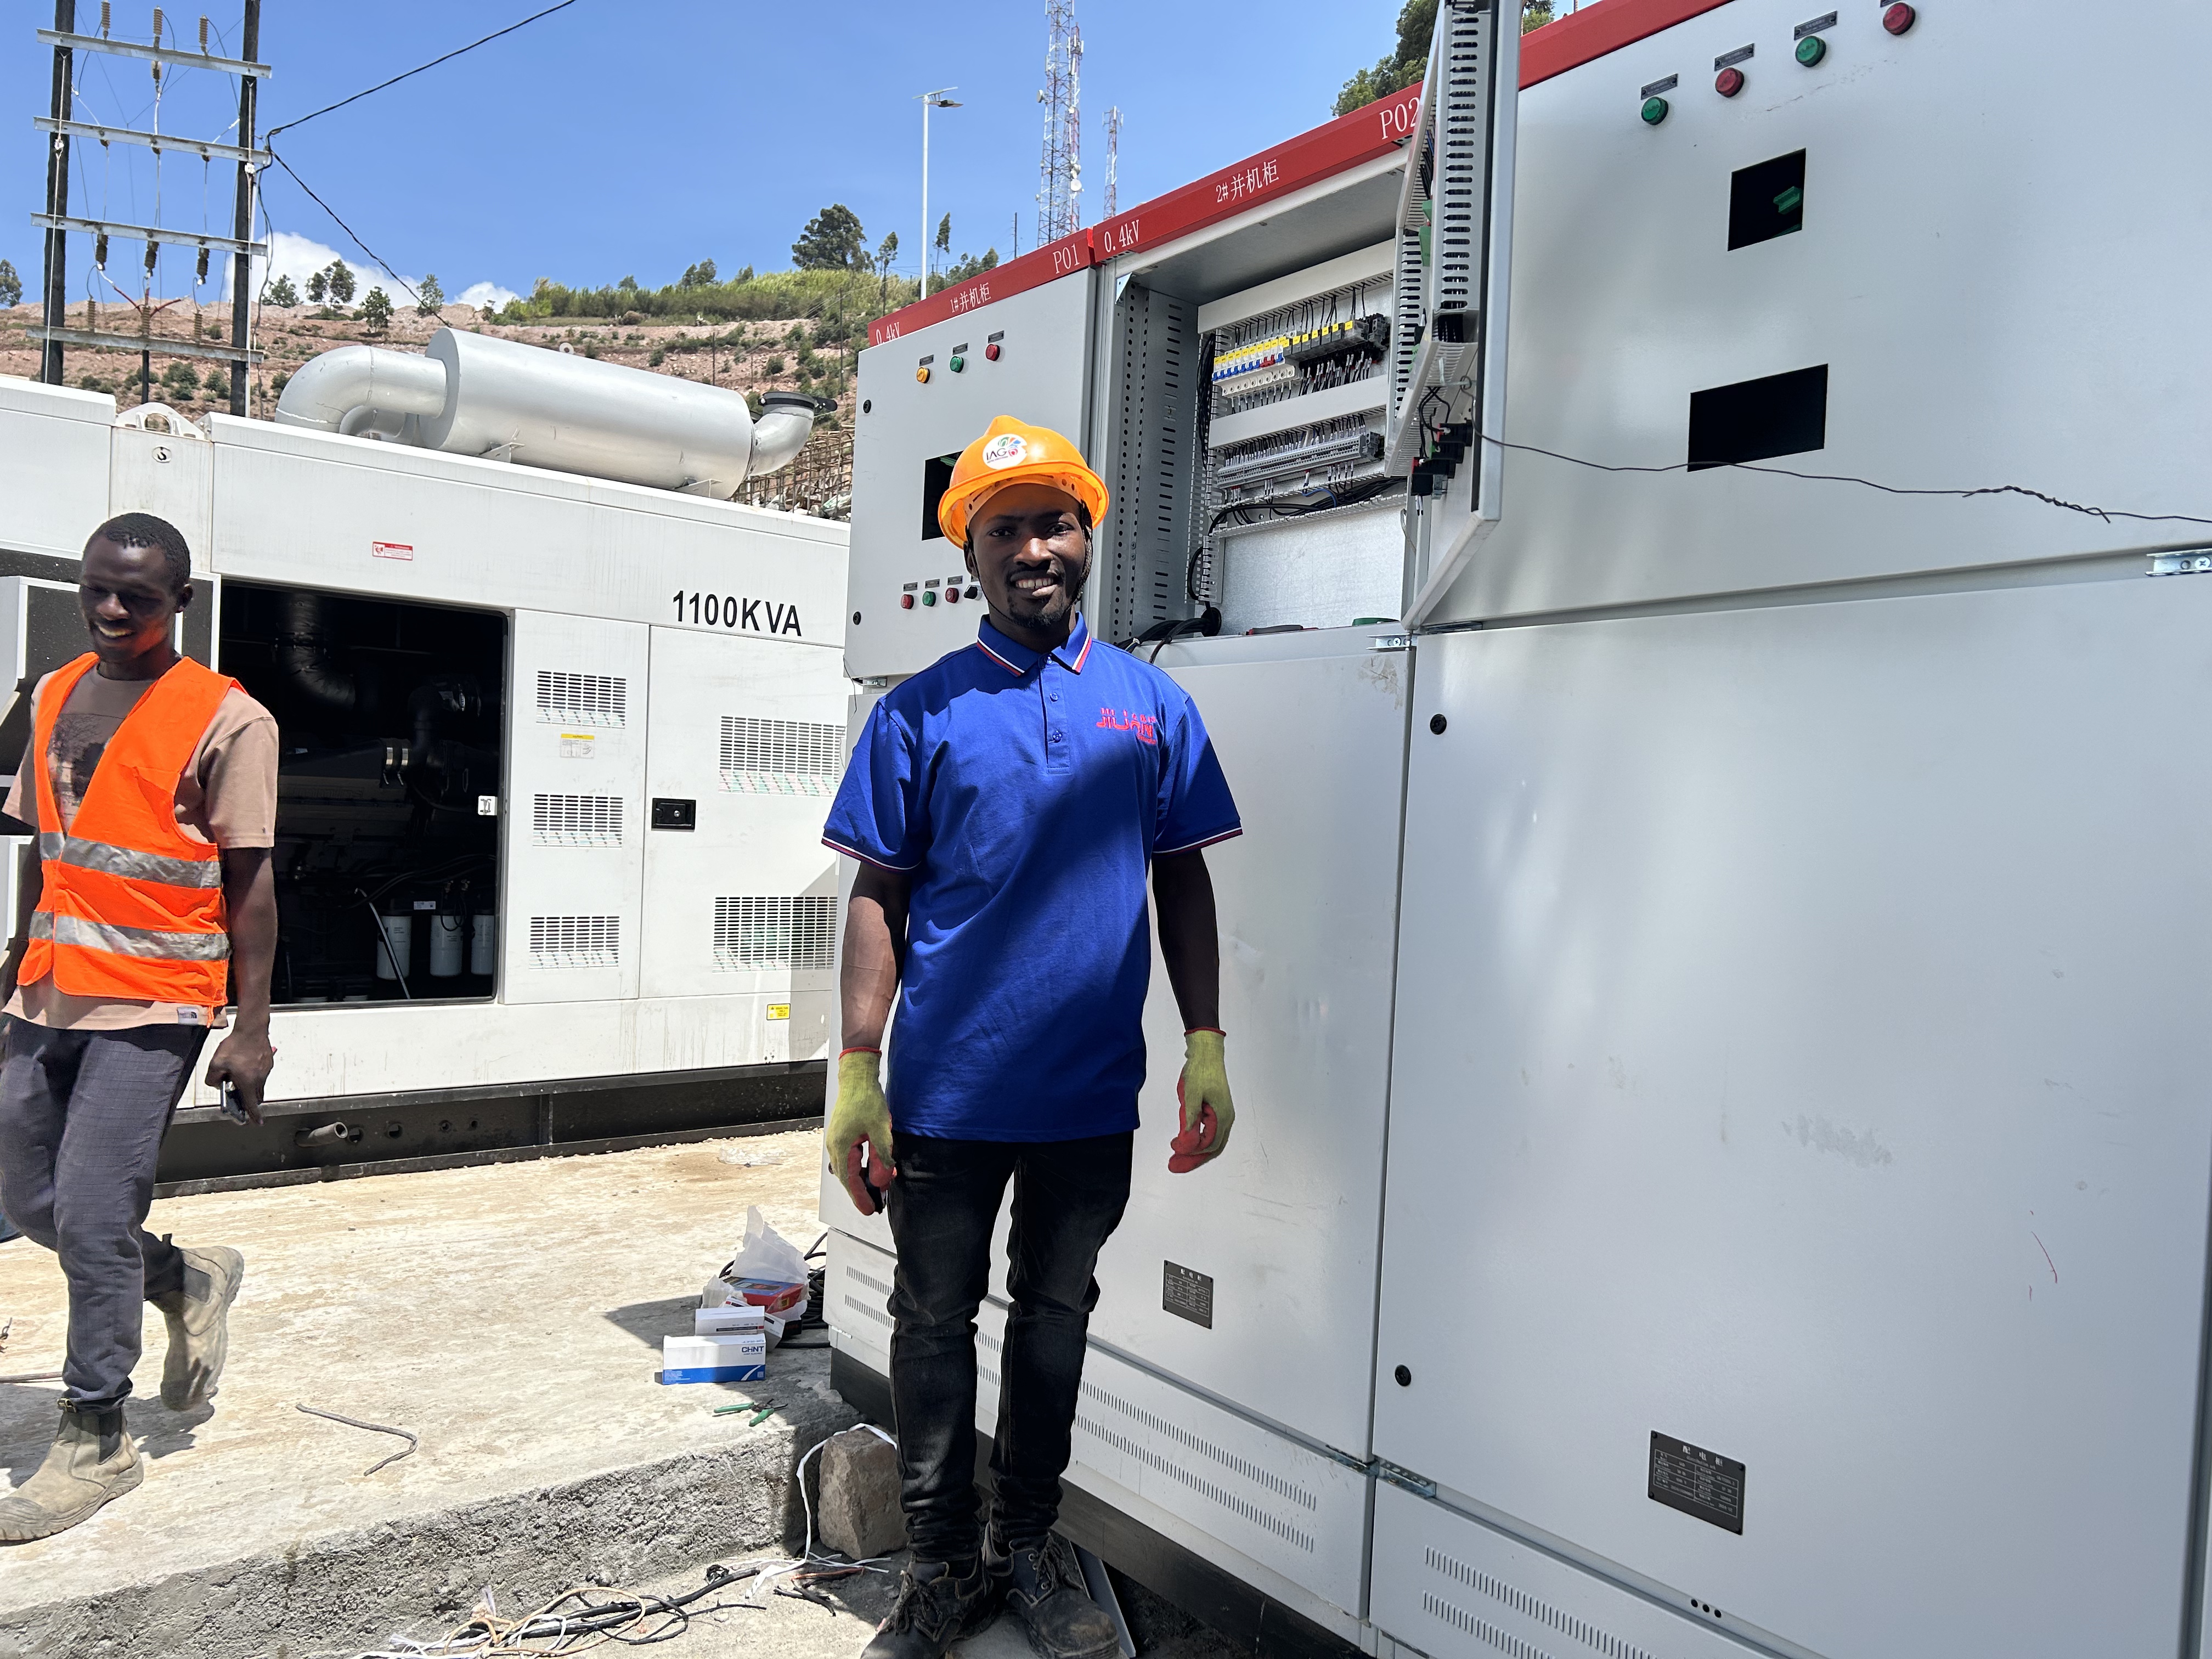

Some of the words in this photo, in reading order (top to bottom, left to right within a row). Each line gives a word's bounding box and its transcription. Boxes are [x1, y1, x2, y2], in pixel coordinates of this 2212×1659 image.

[1379, 97, 1420, 140] P02
[1216, 159, 1279, 203] 2#并机柜
[1053, 243, 1080, 274] P01
[950, 282, 991, 313] 1#并机柜
[673, 590, 802, 636] 1100KVA
